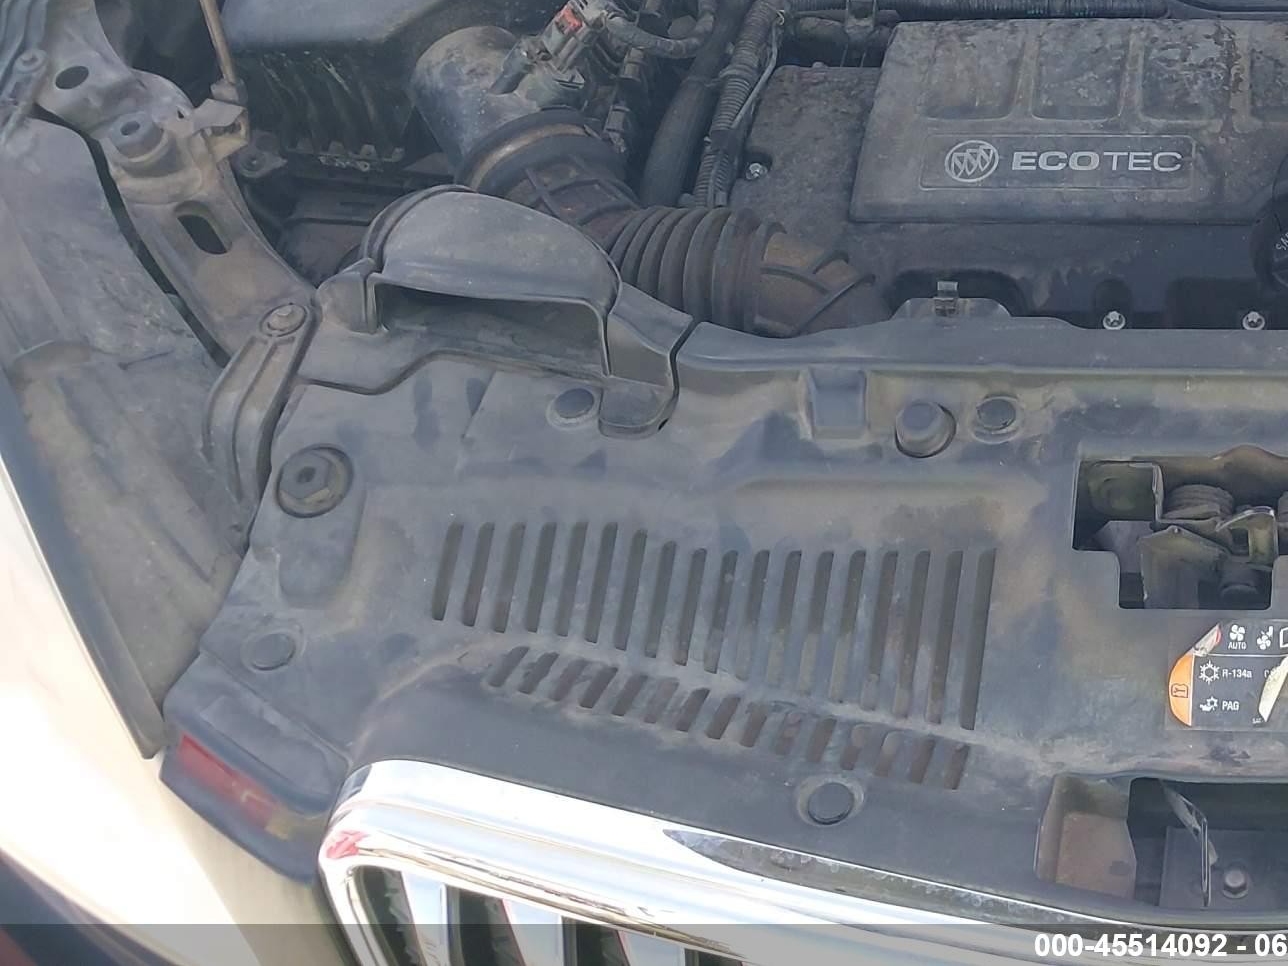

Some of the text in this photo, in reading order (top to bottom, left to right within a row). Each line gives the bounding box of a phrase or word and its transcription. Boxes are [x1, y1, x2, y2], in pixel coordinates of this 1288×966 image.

[1228, 640, 1247, 650] AUTO
[1222, 669, 1253, 679] R-134a
[1222, 700, 1240, 711] PAG
